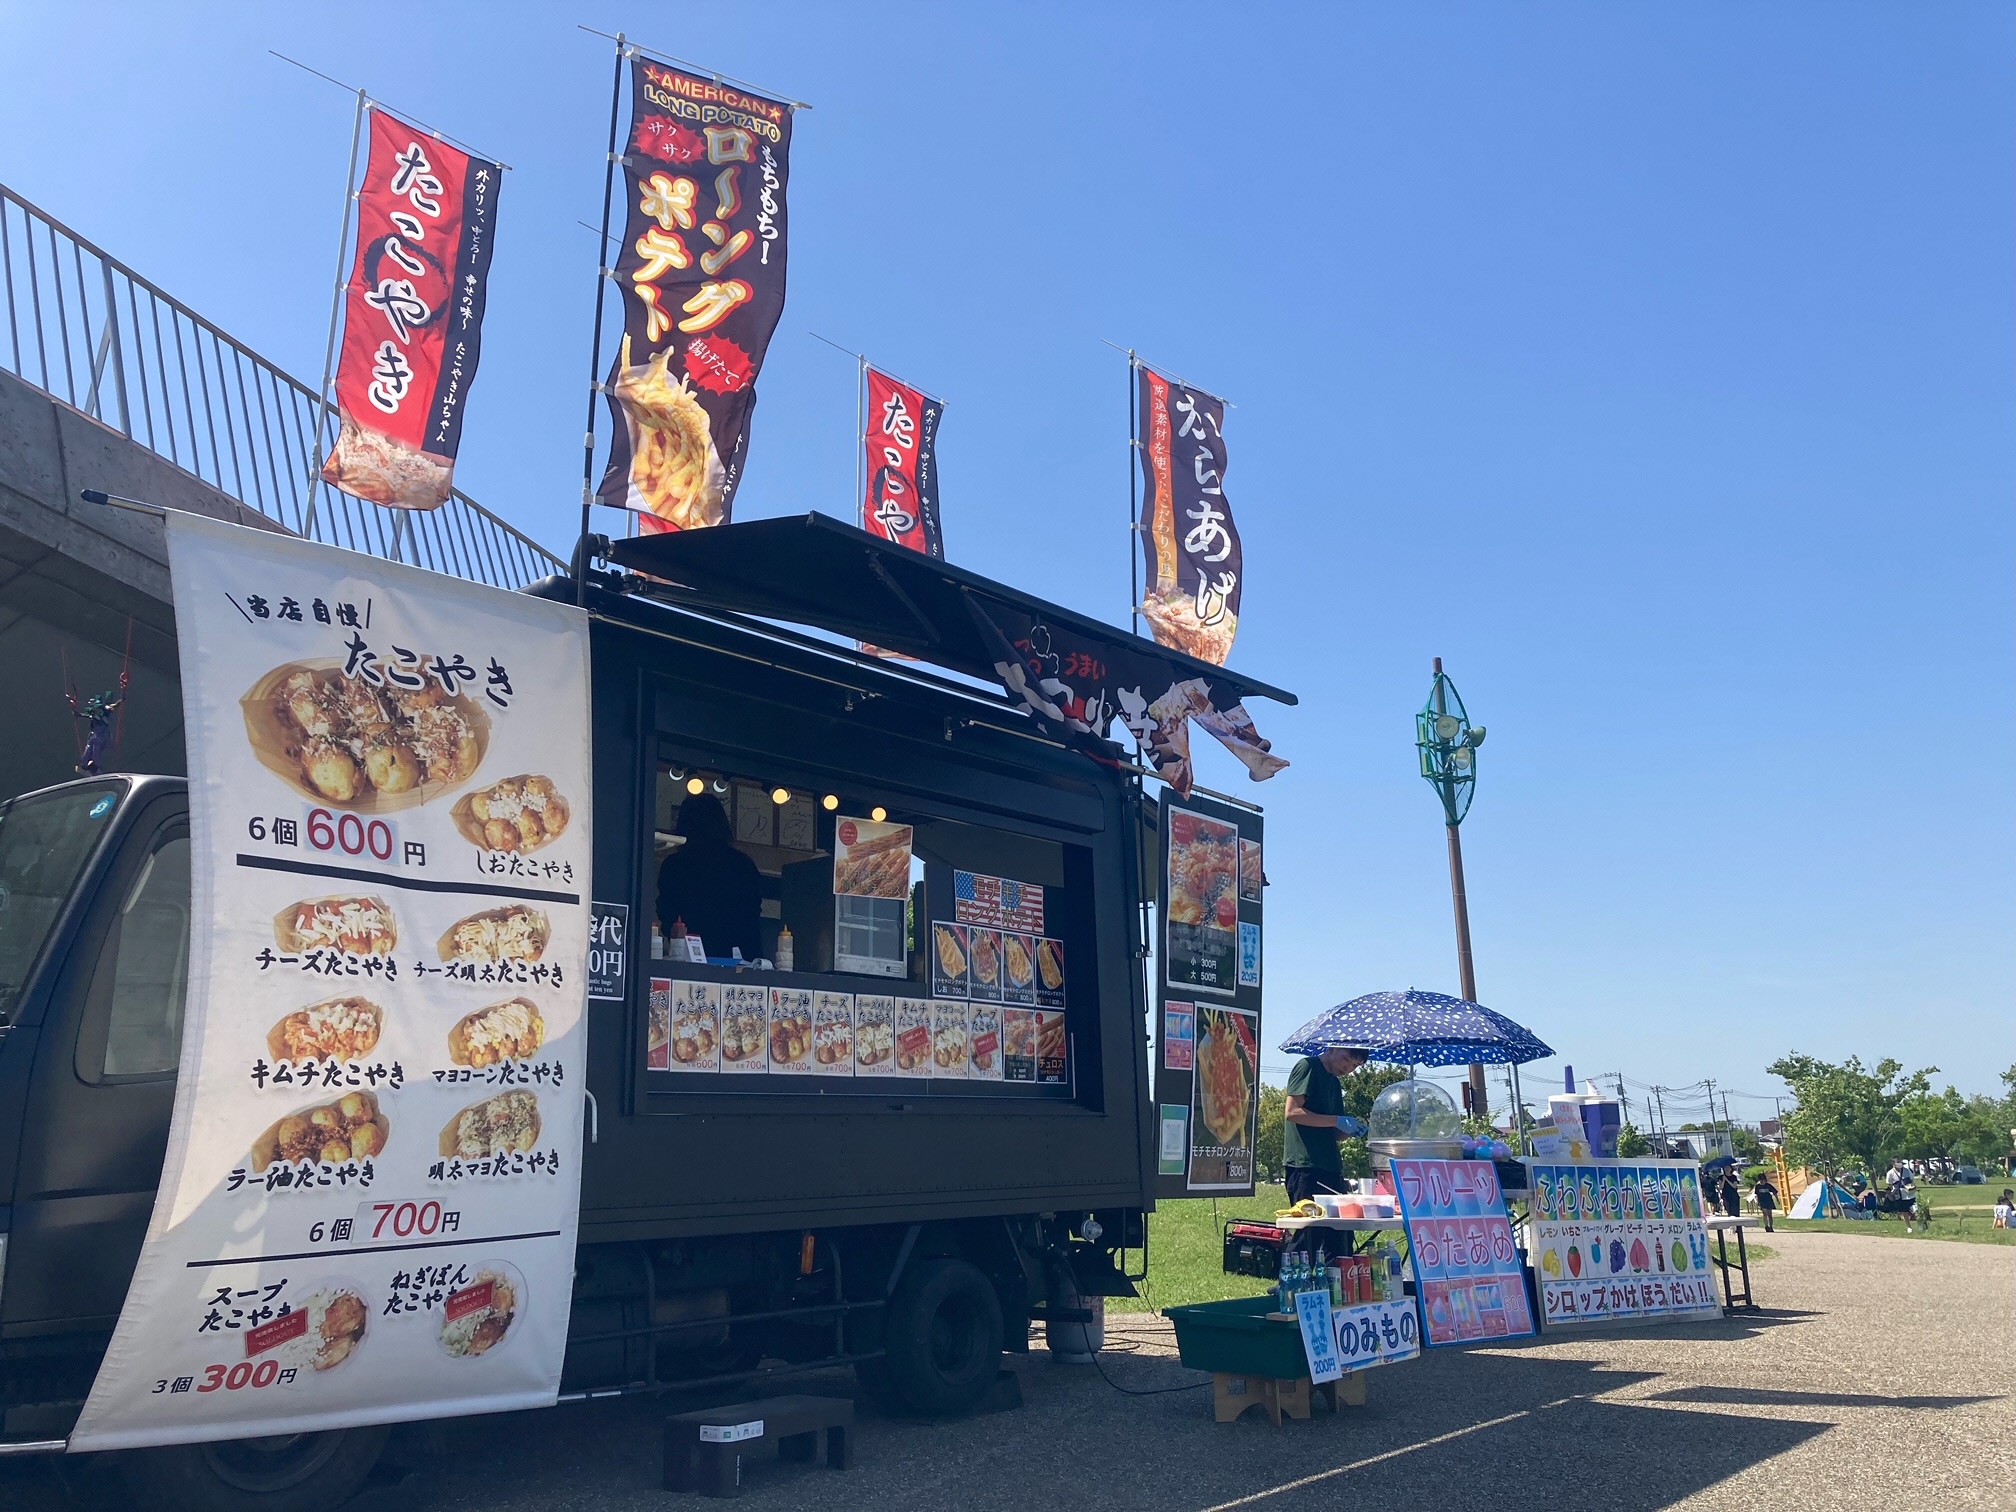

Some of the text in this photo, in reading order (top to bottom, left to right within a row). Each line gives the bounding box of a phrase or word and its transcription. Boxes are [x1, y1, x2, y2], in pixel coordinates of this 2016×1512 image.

[660, 73, 767, 115] AMERICAN
[644, 85, 782, 143] LONG POTATO
[648, 122, 677, 137] サク
[662, 143, 692, 160] サク
[632, 170, 699, 342] ポテト
[364, 142, 443, 413] たこやき
[436, 342, 466, 443] たこやき山ちゃん
[1176, 394, 1236, 627] からあげ
[247, 595, 362, 629] 当店自慢
[344, 631, 514, 707] たこやき
[477, 851, 574, 884] しおたこやき
[975, 877, 1029, 906] モチモチ
[957, 899, 1041, 931] ロングポテト
[1241, 925, 1256, 936] ラムネ
[256, 948, 398, 982] チーズたこやき
[413, 961, 563, 988] チーズ明太たこやき
[1190, 956, 1217, 970] 小 300円
[1190, 970, 1217, 983] 大 500円
[1241, 970, 1258, 983] 200円
[688, 984, 707, 999] しお
[820, 995, 850, 1008] チーズ
[676, 1000, 719, 1018] たこやき
[724, 1003, 766, 1018] たこやき
[770, 1007, 810, 1022] たこやき
[816, 1008, 852, 1023] たこやき
[857, 1011, 894, 1026] たこやき
[897, 1013, 932, 1028] たこやき
[901, 1001, 928, 1014] キムチ
[935, 1016, 968, 1030] たこやき
[251, 1059, 404, 1090] キムチたこやき
[432, 1061, 564, 1088] マヨコーンたこやき
[1039, 1058, 1064, 1069] チュロス
[428, 1148, 560, 1181] 明太マヨたこやき
[1192, 1145, 1250, 1158] モチモチロングポテト
[227, 1156, 375, 1193] ラー油たこやき
[1401, 1174, 1495, 1208] フルーツ
[1536, 1178, 1682, 1216] ふわふわかき氷
[1539, 1226, 1559, 1239] レモン
[1561, 1225, 1581, 1237] いちご
[1604, 1223, 1624, 1234] グレープ
[1626, 1222, 1644, 1234] ピーチ
[1647, 1223, 1665, 1234] コーラ
[1667, 1222, 1684, 1235] メロン
[1686, 1221, 1703, 1233] ラムネ
[1415, 1230, 1514, 1269] わたあめ
[390, 1264, 470, 1290] ねぎぽん
[213, 1279, 288, 1307] スープ
[1301, 1294, 1325, 1311] ラムネ
[1503, 1294, 1526, 1312] 600
[1339, 1311, 1417, 1357] のみもの
[1313, 1357, 1337, 1375] 200円
